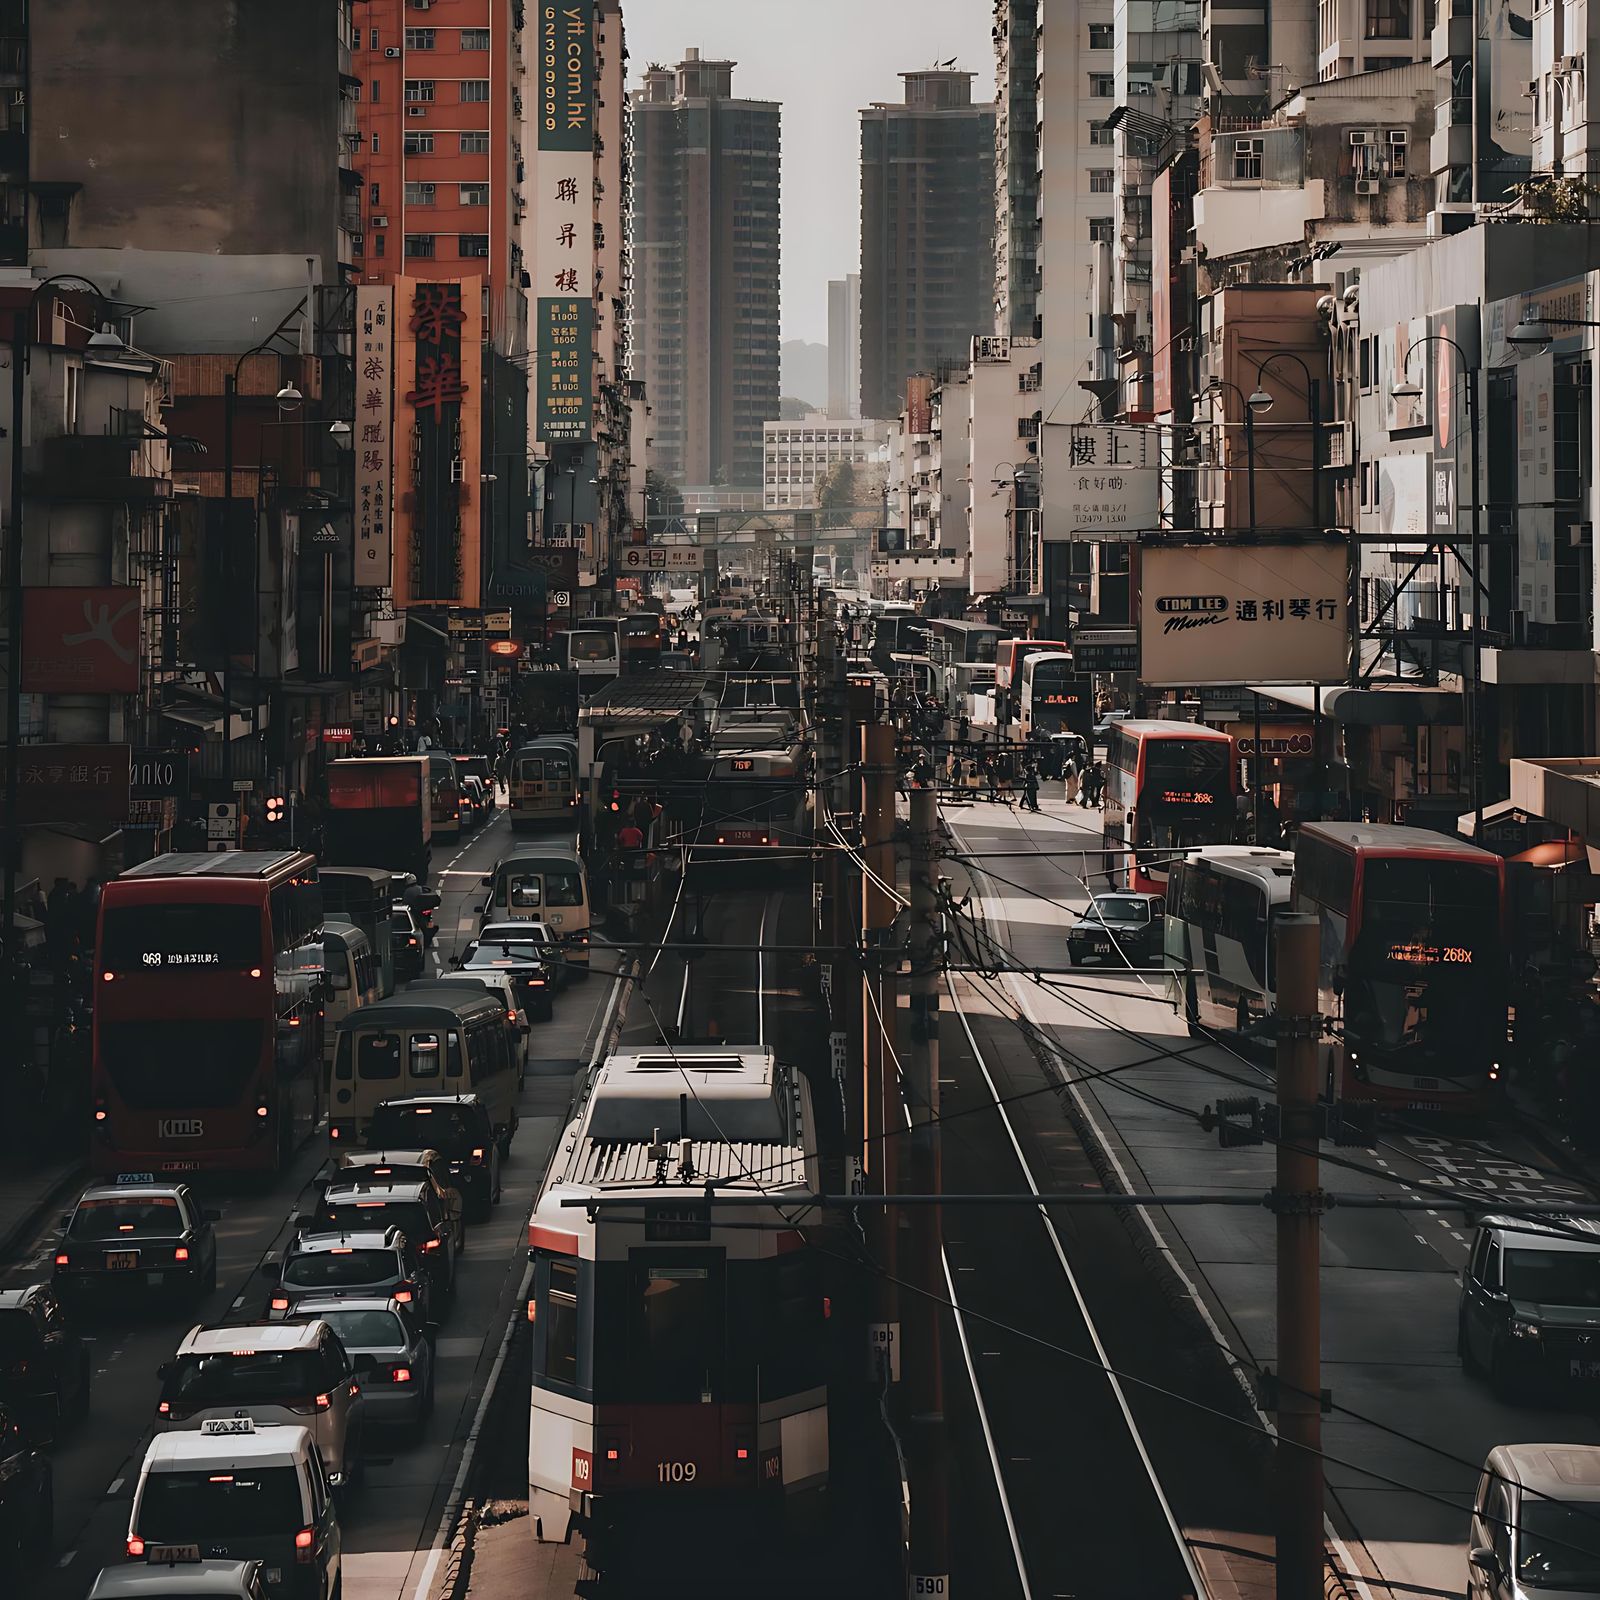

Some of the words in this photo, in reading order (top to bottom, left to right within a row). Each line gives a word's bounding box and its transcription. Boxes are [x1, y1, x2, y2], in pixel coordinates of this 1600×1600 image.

[545, 7, 556, 130] 62399999
[555, 177, 579, 293] 聯昇樓
[1162, 599, 1192, 611] TOM
[1198, 598, 1222, 610] LEE
[1236, 599, 1338, 622] 通利琴行
[1164, 613, 1229, 635] Music
[1442, 947, 1472, 963] 268X
[158, 1119, 204, 1139] KMB
[206, 1421, 250, 1432] TAXI
[657, 1462, 697, 1483] 1109
[157, 1549, 193, 1561] TAXI
